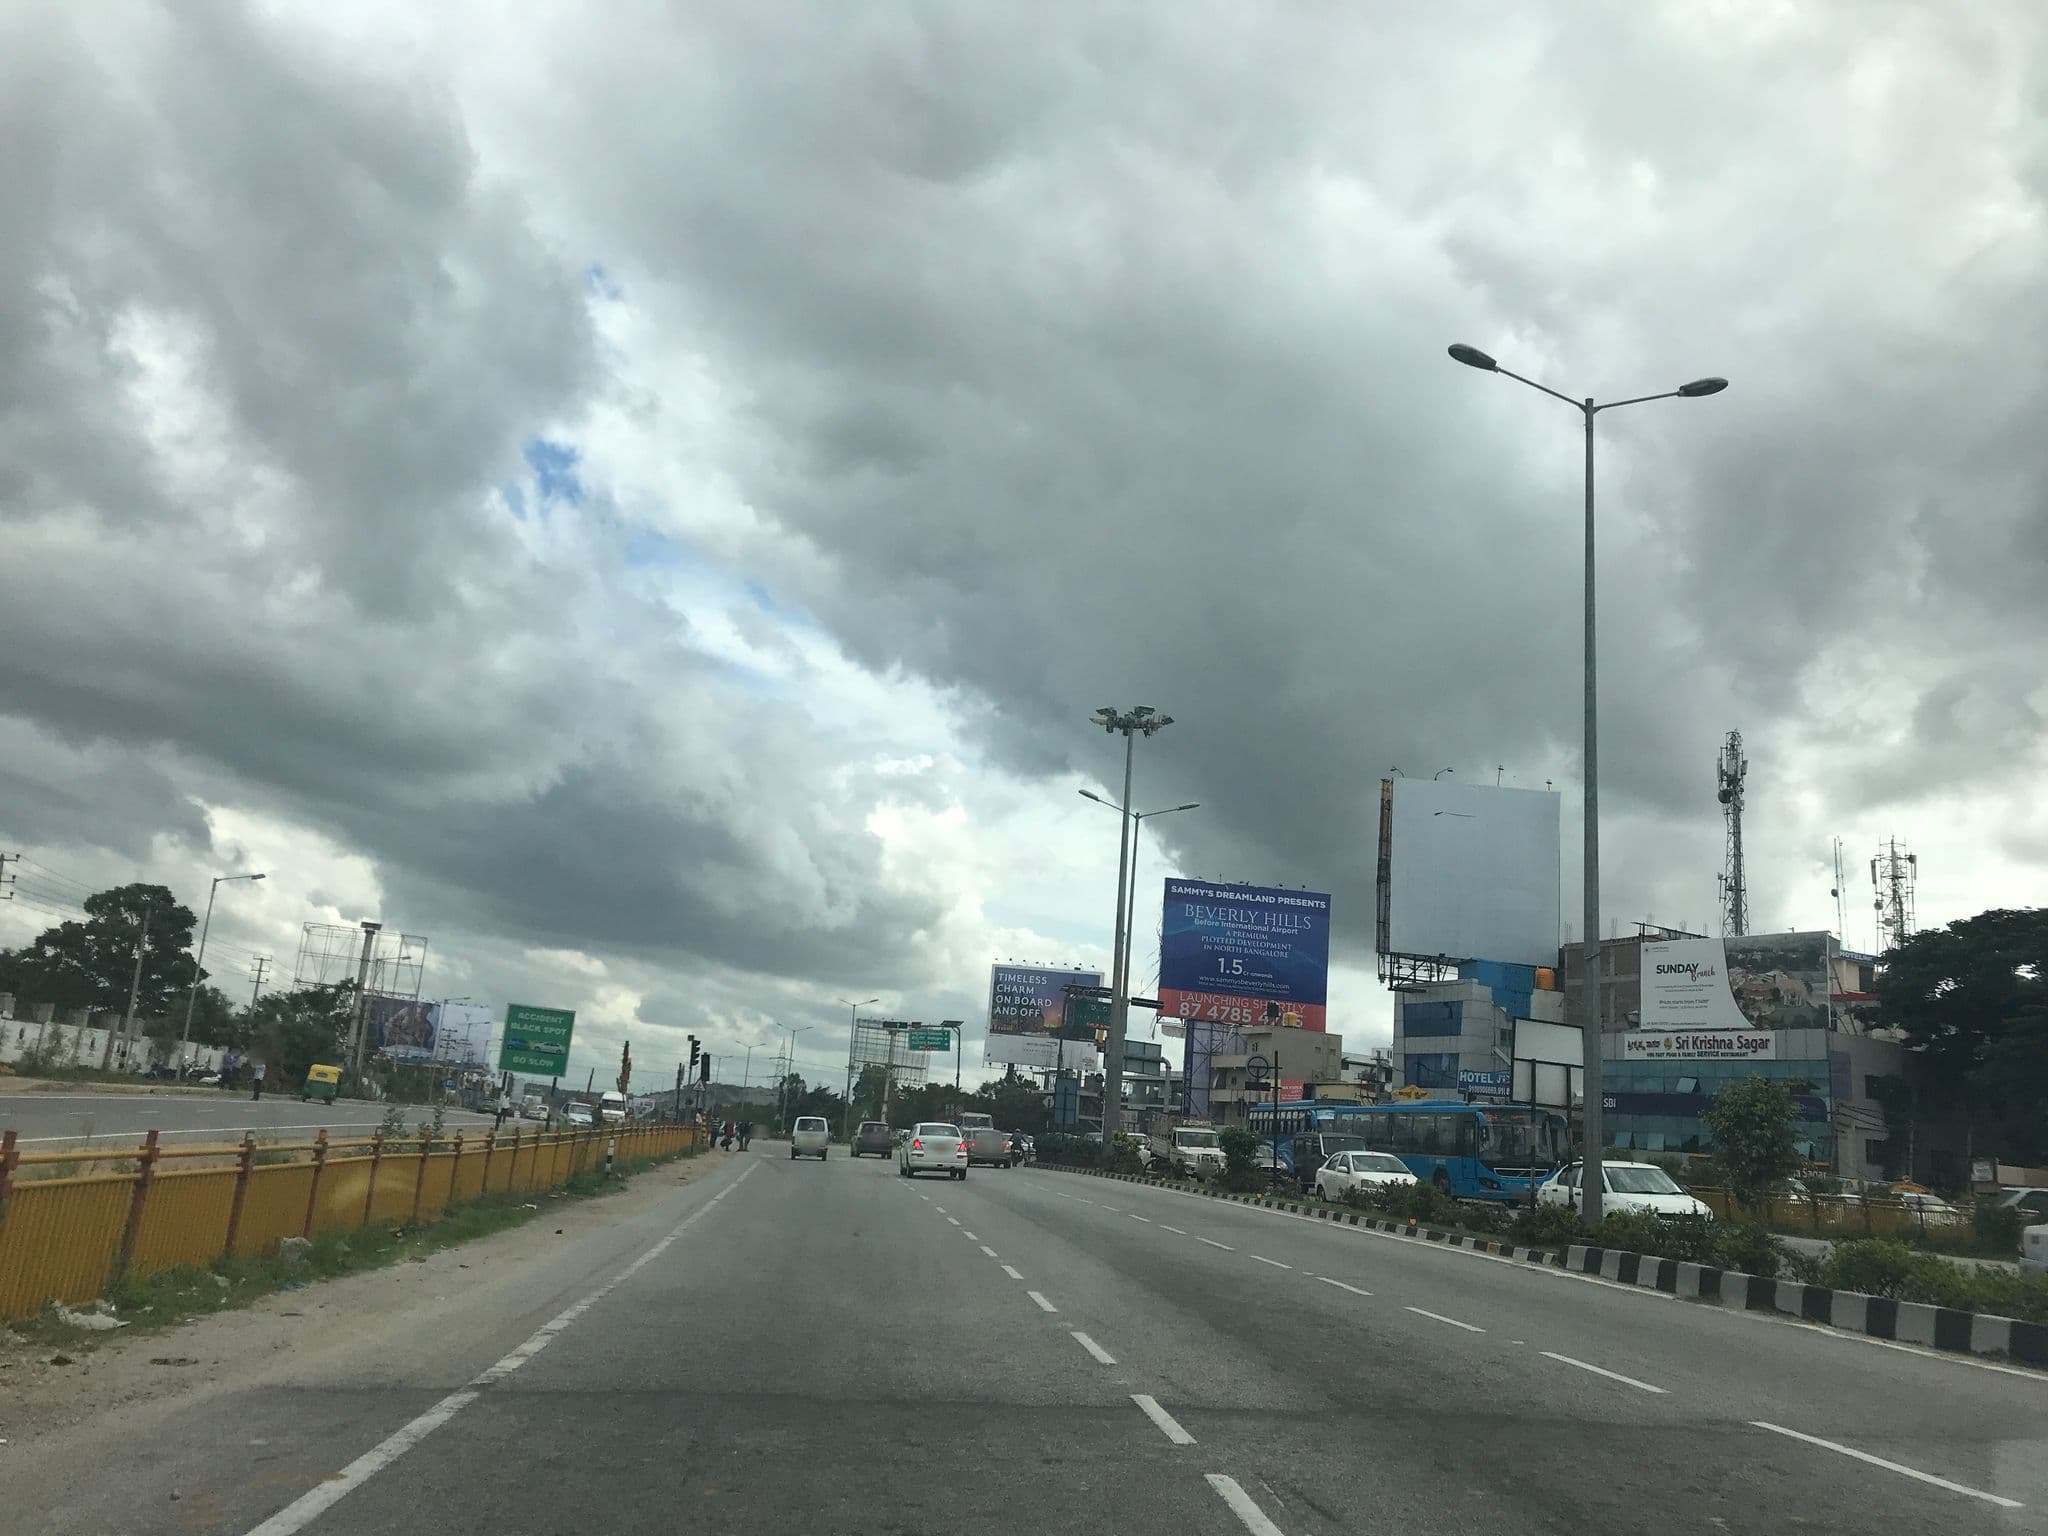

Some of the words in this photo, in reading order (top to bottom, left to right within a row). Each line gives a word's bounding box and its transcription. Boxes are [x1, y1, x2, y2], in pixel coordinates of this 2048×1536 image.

[1171, 885, 1214, 898] SAMMY'S
[1216, 890, 1276, 904] DREAMLAND
[1278, 896, 1326, 909] PRESENTS
[1184, 903, 1259, 924] BEVERLY
[1264, 911, 1312, 930] HILLS
[1194, 918, 1220, 927] Before
[1221, 920, 1269, 932] International
[1271, 925, 1298, 936] Airport
[1233, 930, 1269, 941] PREMIUM
[1201, 935, 1236, 945] PLOTTED
[1237, 938, 1292, 951] DEVELOPMENT
[1203, 943, 1212, 951] IN
[1214, 944, 1242, 954] NORTH
[1244, 948, 1290, 959] BANGALORE
[1656, 963, 1699, 975] SUNDAY
[998, 973, 1047, 985] TIMELESS
[996, 983, 1034, 995] CHARM
[995, 994, 1011, 1004] ON
[1014, 996, 1052, 1007] BOARD
[1179, 991, 1250, 1008] LAUNCHING
[1252, 1000, 1307, 1014] SHRTLY
[519, 1013, 564, 1023] ACCIDENT
[994, 1006, 1018, 1016] AND
[1020, 1007, 1041, 1017] OFF
[1179, 1002, 1202, 1017] 87
[1207, 1005, 1252, 1023] 4785
[511, 1022, 541, 1032] BLACK
[543, 1027, 567, 1035] SPOT
[1675, 1036, 1691, 1050] Sri
[1692, 1035, 1733, 1050] Krishna
[1736, 1035, 1770, 1053] Sagar
[513, 1056, 526, 1064] GO
[528, 1058, 554, 1067] SLOW
[1459, 1071, 1493, 1084] HOTEL
[1603, 1097, 1616, 1108] SBI
